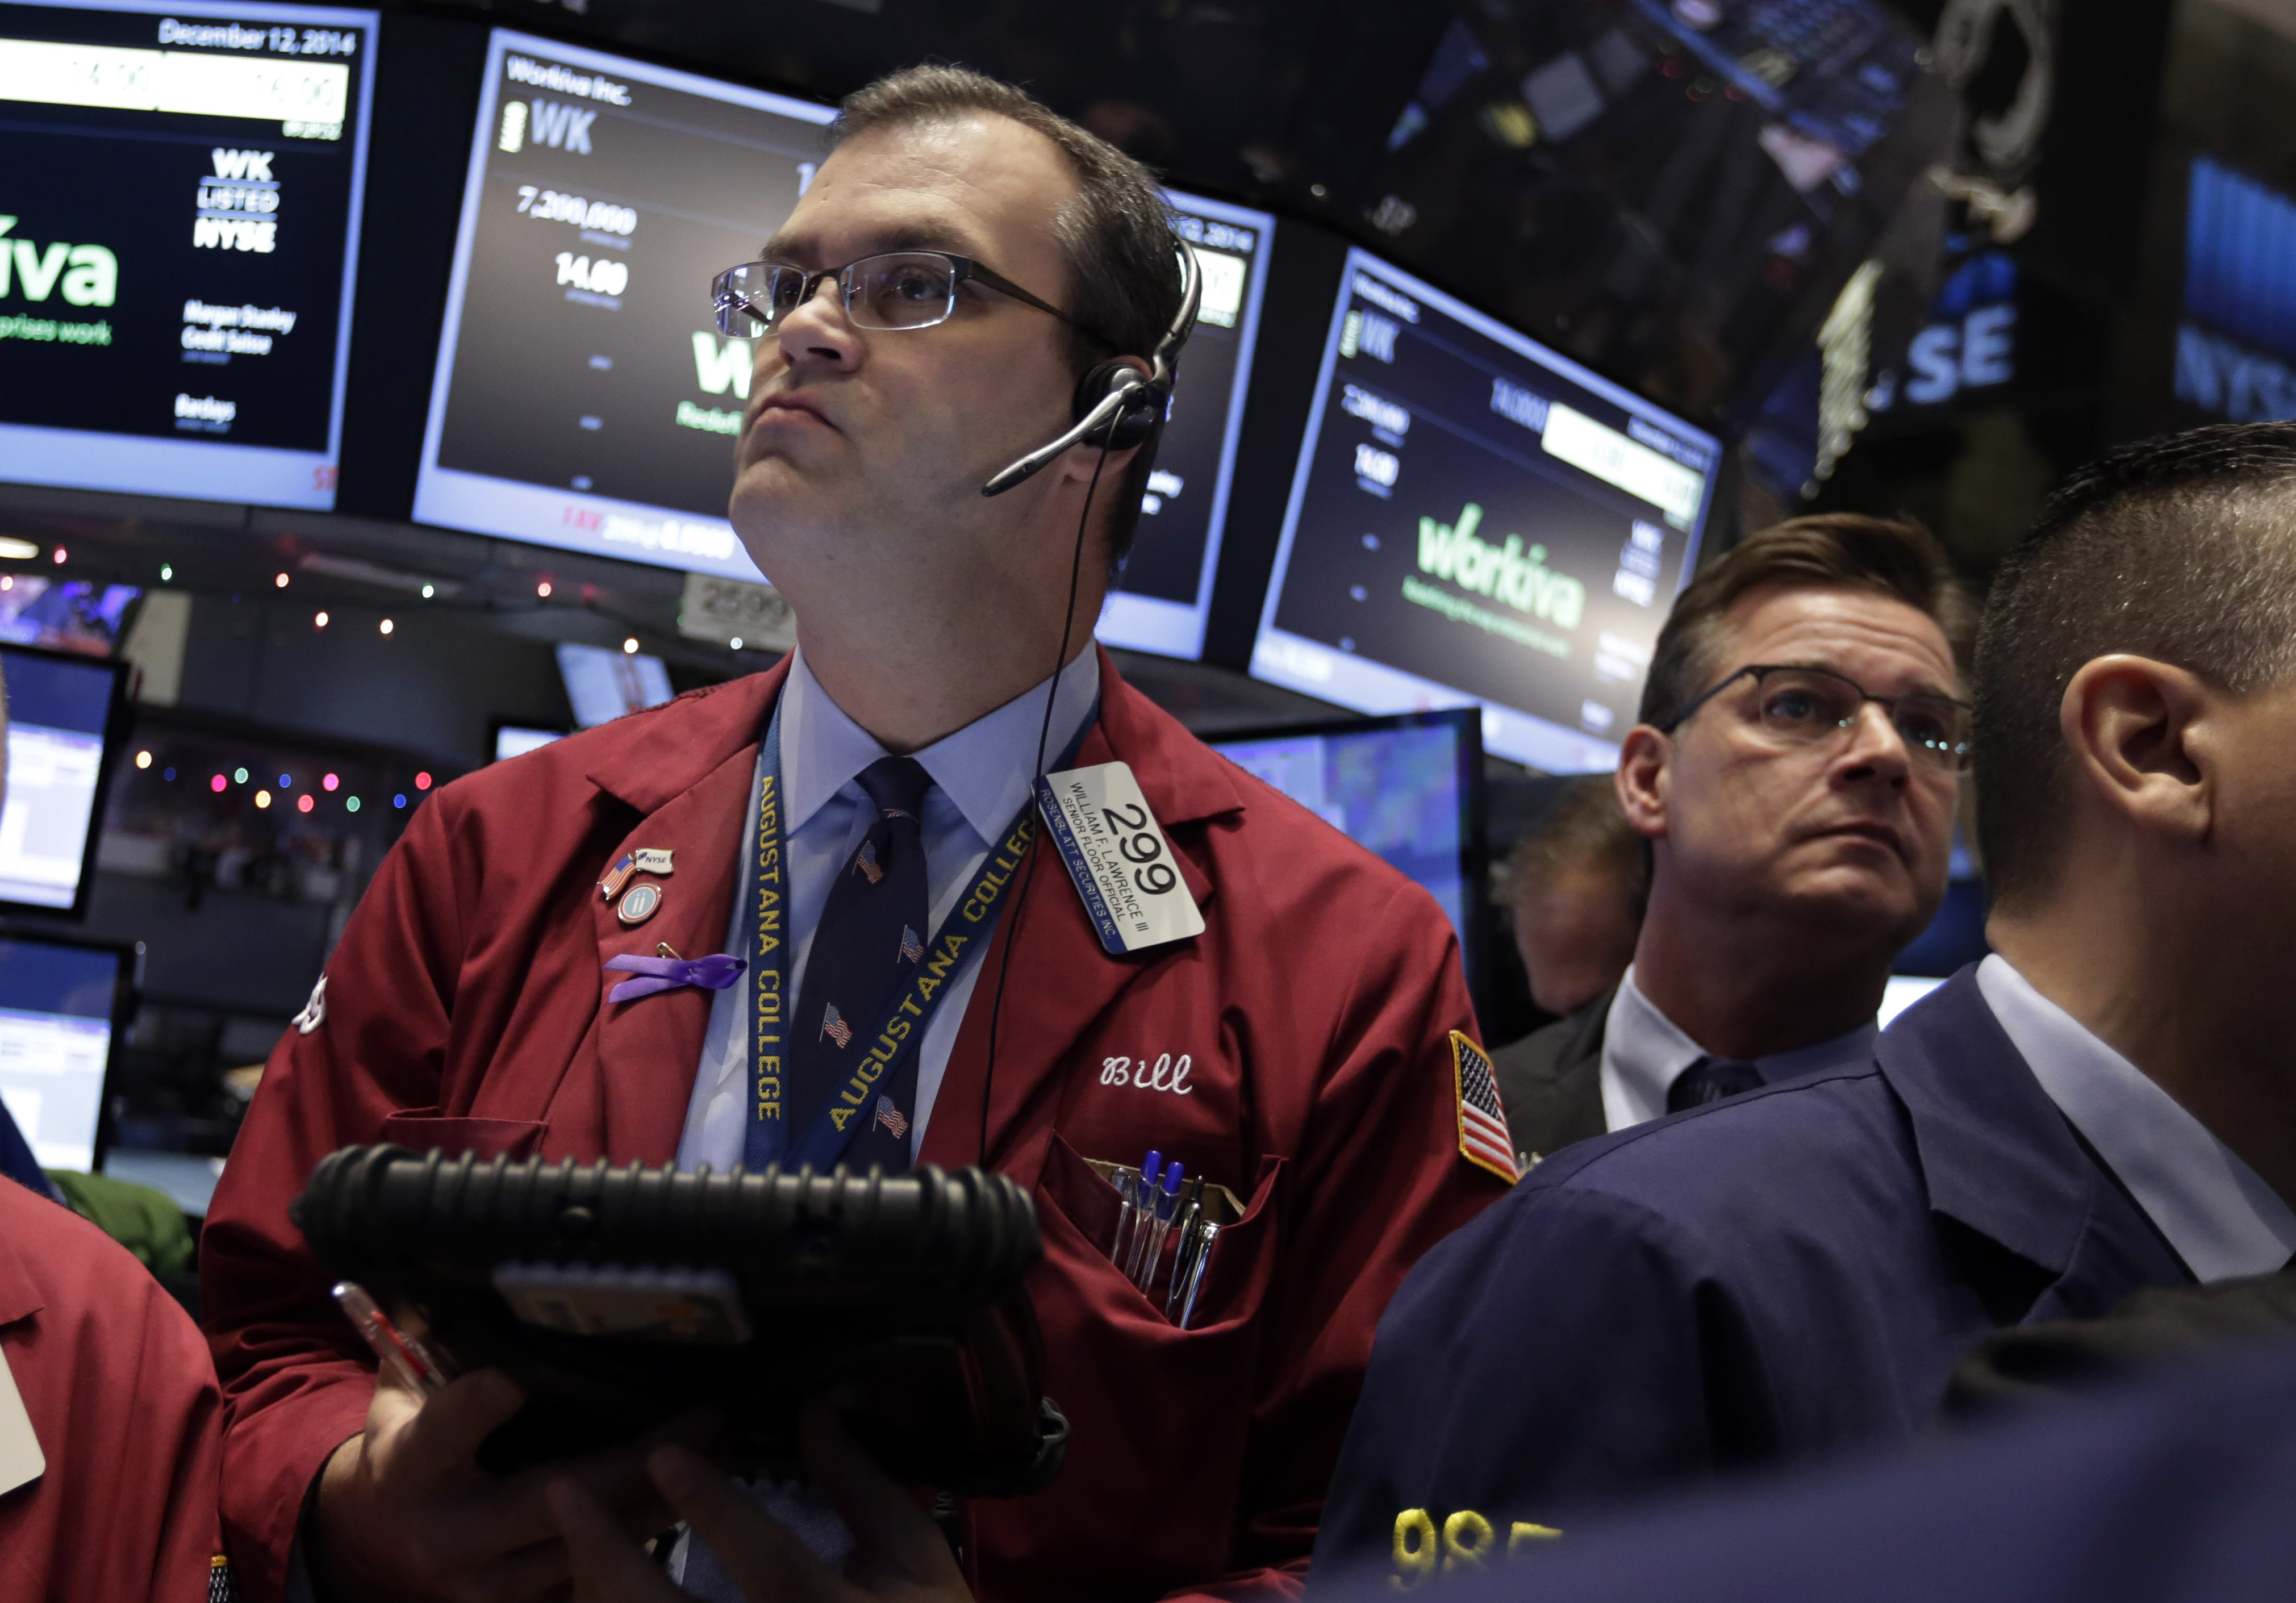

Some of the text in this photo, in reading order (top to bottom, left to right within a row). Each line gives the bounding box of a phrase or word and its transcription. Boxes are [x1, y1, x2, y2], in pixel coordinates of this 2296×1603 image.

[158, 18, 356, 56] December 12, 2014
[507, 56, 591, 97] Workiva
[531, 98, 598, 155] WK
[211, 147, 275, 182] WK
[197, 186, 280, 213] LISTED
[194, 218, 277, 253] NYSE
[58, 319, 112, 346] work
[1905, 304, 2017, 406] SE
[1041, 789, 1116, 939] ROSENBLATT SECURITIES INC.
[1063, 798, 1126, 922] SENIOR FLOOR OFFICIAL
[1070, 782, 1149, 932] WILLIAM F. LAWRENCE III
[1101, 804, 1176, 895] 299
[758, 776, 780, 1121] AUGUSTANA COLLEGE
[829, 818, 1034, 1132] AUGUSTANA COLLEG
[1100, 1053, 1192, 1095] Bill
